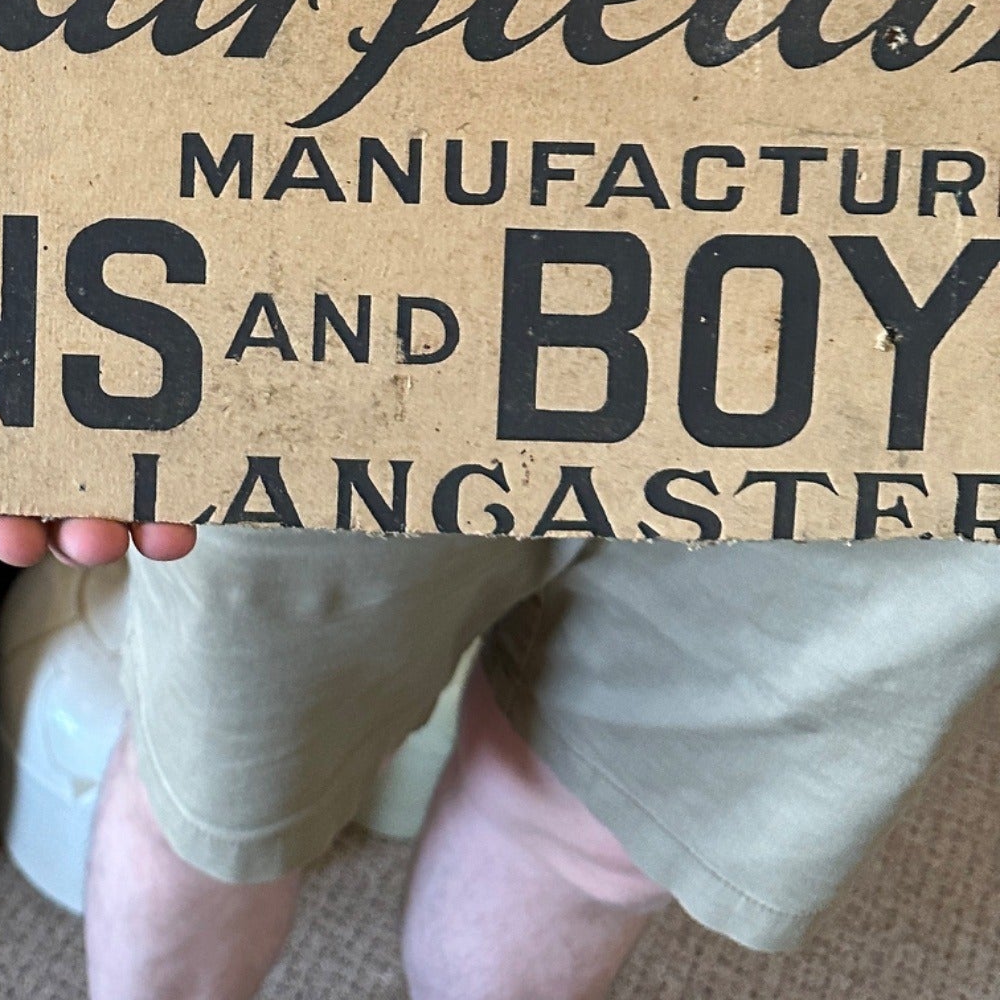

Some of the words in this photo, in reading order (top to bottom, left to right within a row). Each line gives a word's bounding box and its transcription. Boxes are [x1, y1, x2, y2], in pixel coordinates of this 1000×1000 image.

[179, 132, 1000, 218] MANUFACTUR
[224, 292, 461, 365] AND
[495, 227, 1000, 452] BOY
